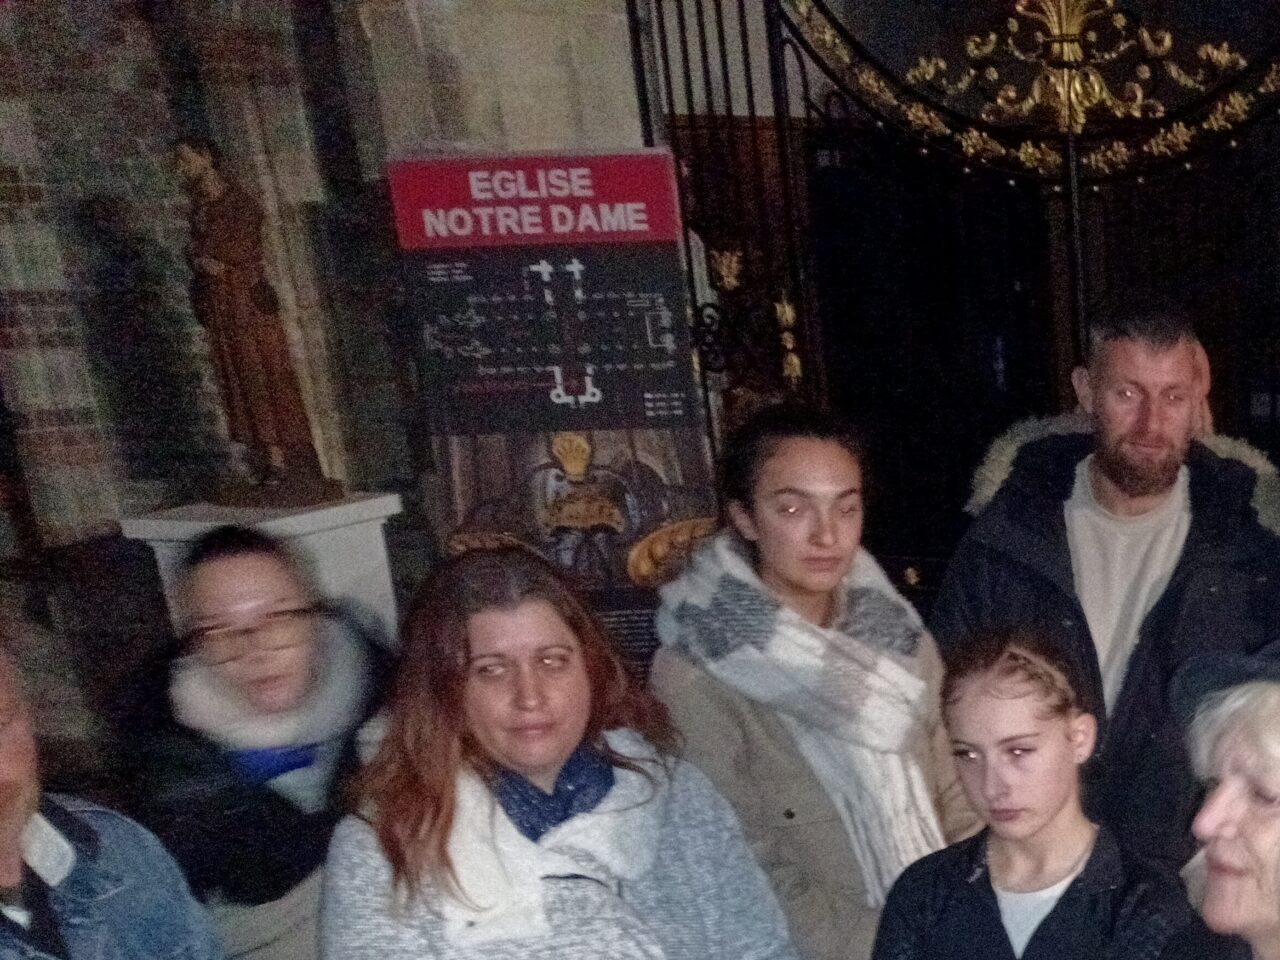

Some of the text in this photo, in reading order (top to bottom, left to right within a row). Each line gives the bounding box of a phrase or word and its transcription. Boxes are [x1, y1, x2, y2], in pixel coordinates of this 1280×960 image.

[468, 167, 595, 200] EGLISE
[422, 202, 649, 237] NOTRE DAME
